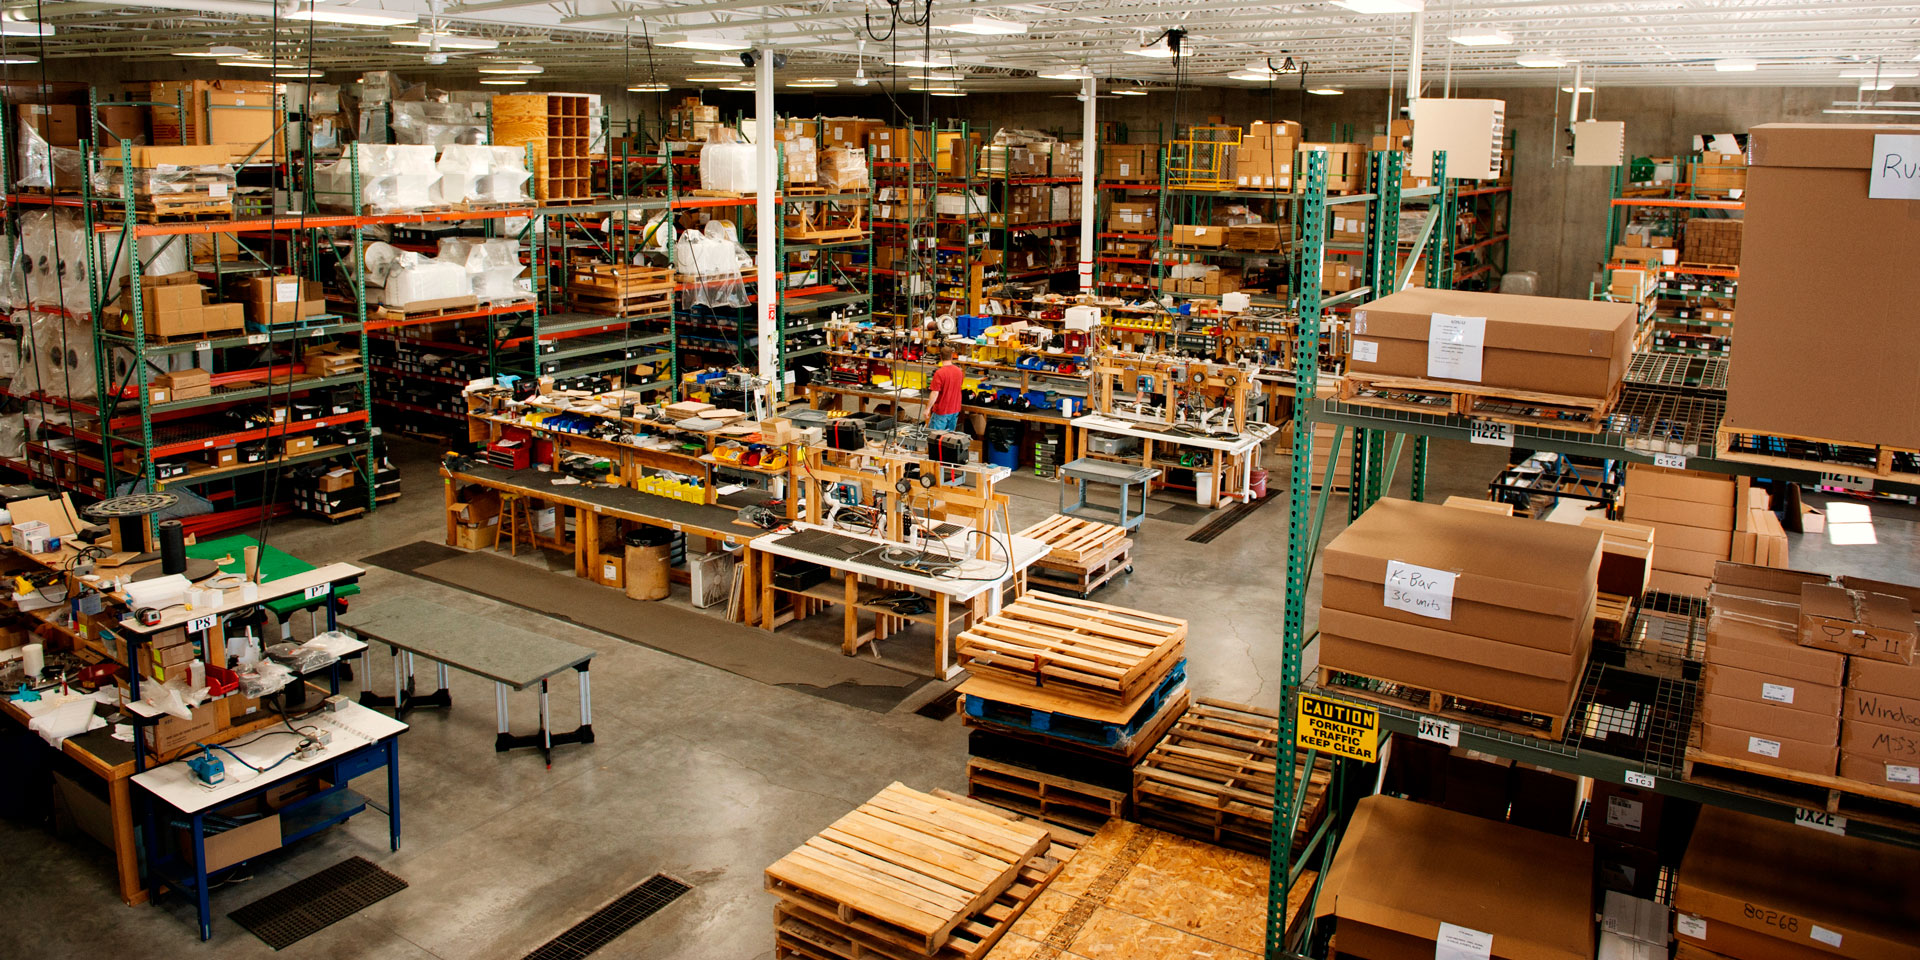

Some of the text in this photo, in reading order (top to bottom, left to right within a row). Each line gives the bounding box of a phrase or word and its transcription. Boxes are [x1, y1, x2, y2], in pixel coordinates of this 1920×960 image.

[1882, 153, 1920, 179] Ru
[1471, 422, 1506, 440] H22E
[1390, 569, 1438, 590] K-Bar
[311, 584, 325, 597] P7
[1391, 589, 1441, 611] 36 units
[195, 616, 211, 630] P8
[1303, 699, 1373, 727] CAUTION
[1309, 718, 1365, 738] FORKLIFT
[1312, 728, 1360, 746] TRAFFIC
[1418, 720, 1450, 740] JX1E
[1300, 735, 1372, 759] KEEP CLEAR
[1796, 808, 1835, 827] JX2E
[1743, 903, 1799, 933] 80268
